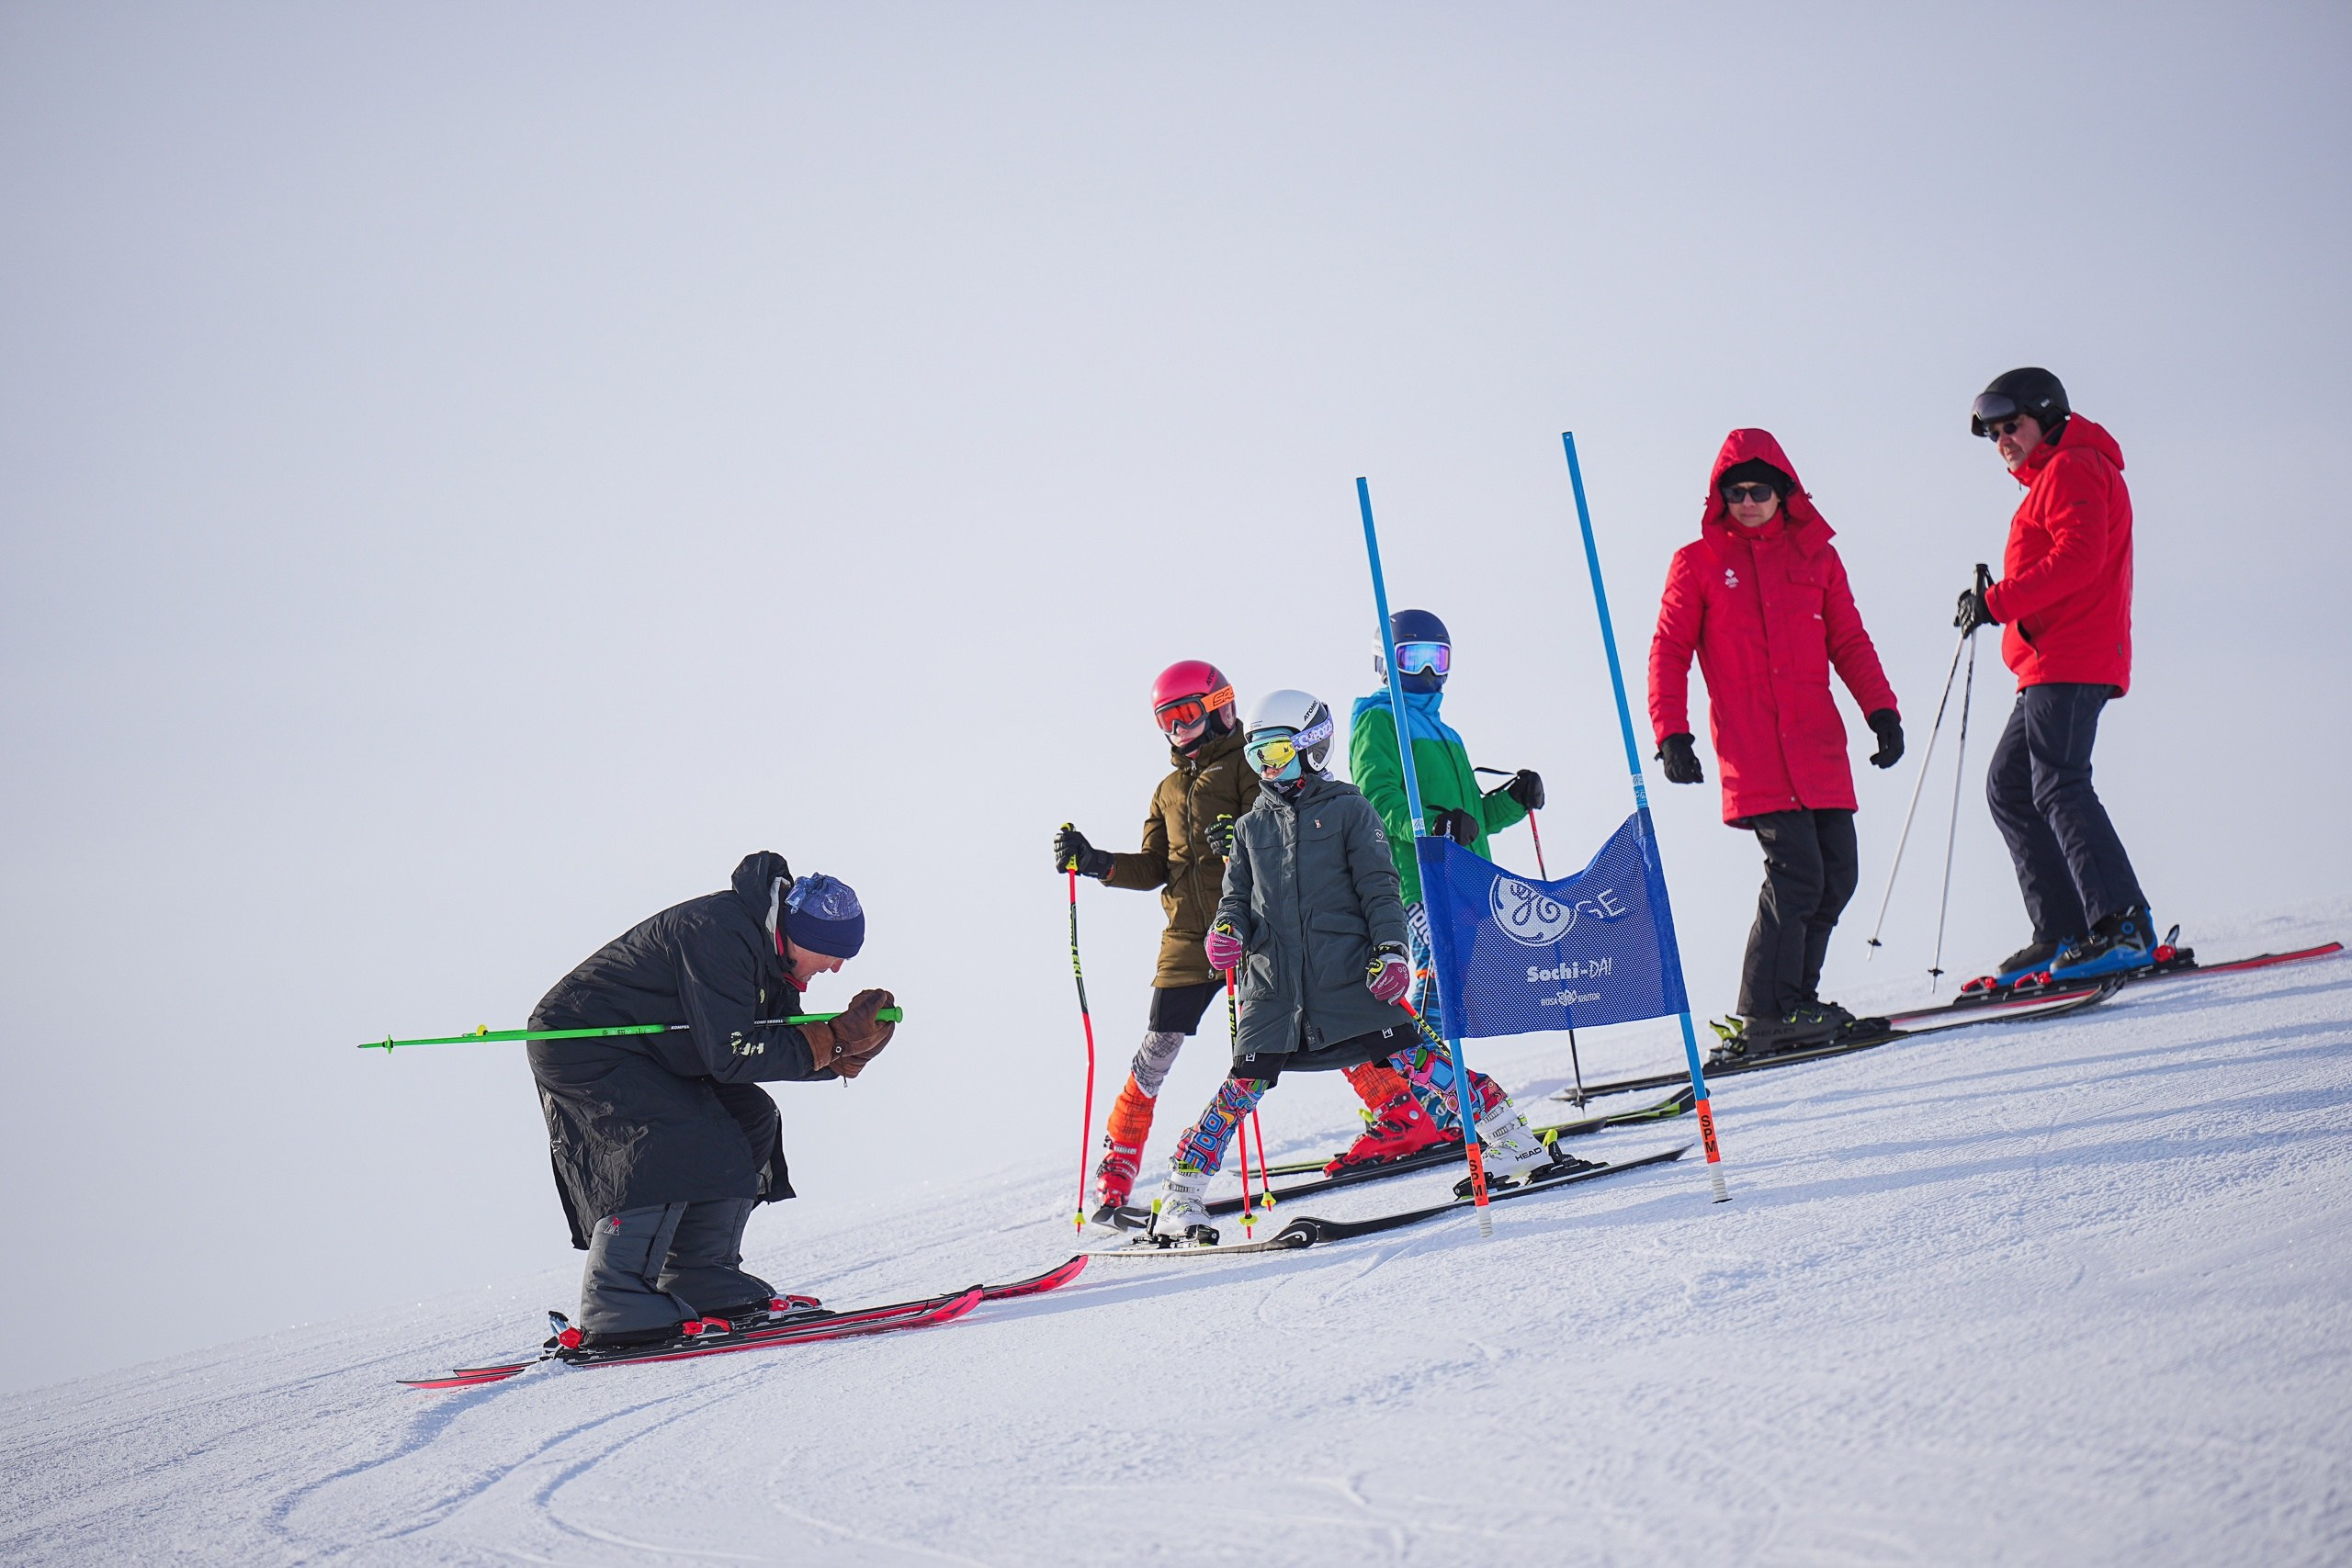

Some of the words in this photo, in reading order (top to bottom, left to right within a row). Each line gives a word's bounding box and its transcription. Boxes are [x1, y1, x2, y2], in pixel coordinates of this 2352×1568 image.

[1303, 700, 1318, 722] ATOMIC
[1575, 888, 1626, 919] GE
[1070, 945, 1082, 978] LEKI
[1526, 956, 1612, 983] Sochi-DA!
[1419, 1019, 1441, 1043] LEKI
[1701, 1114, 1716, 1153] SPM
[1514, 1146, 1543, 1162] HEAD
[1469, 1159, 1483, 1197] SPM
